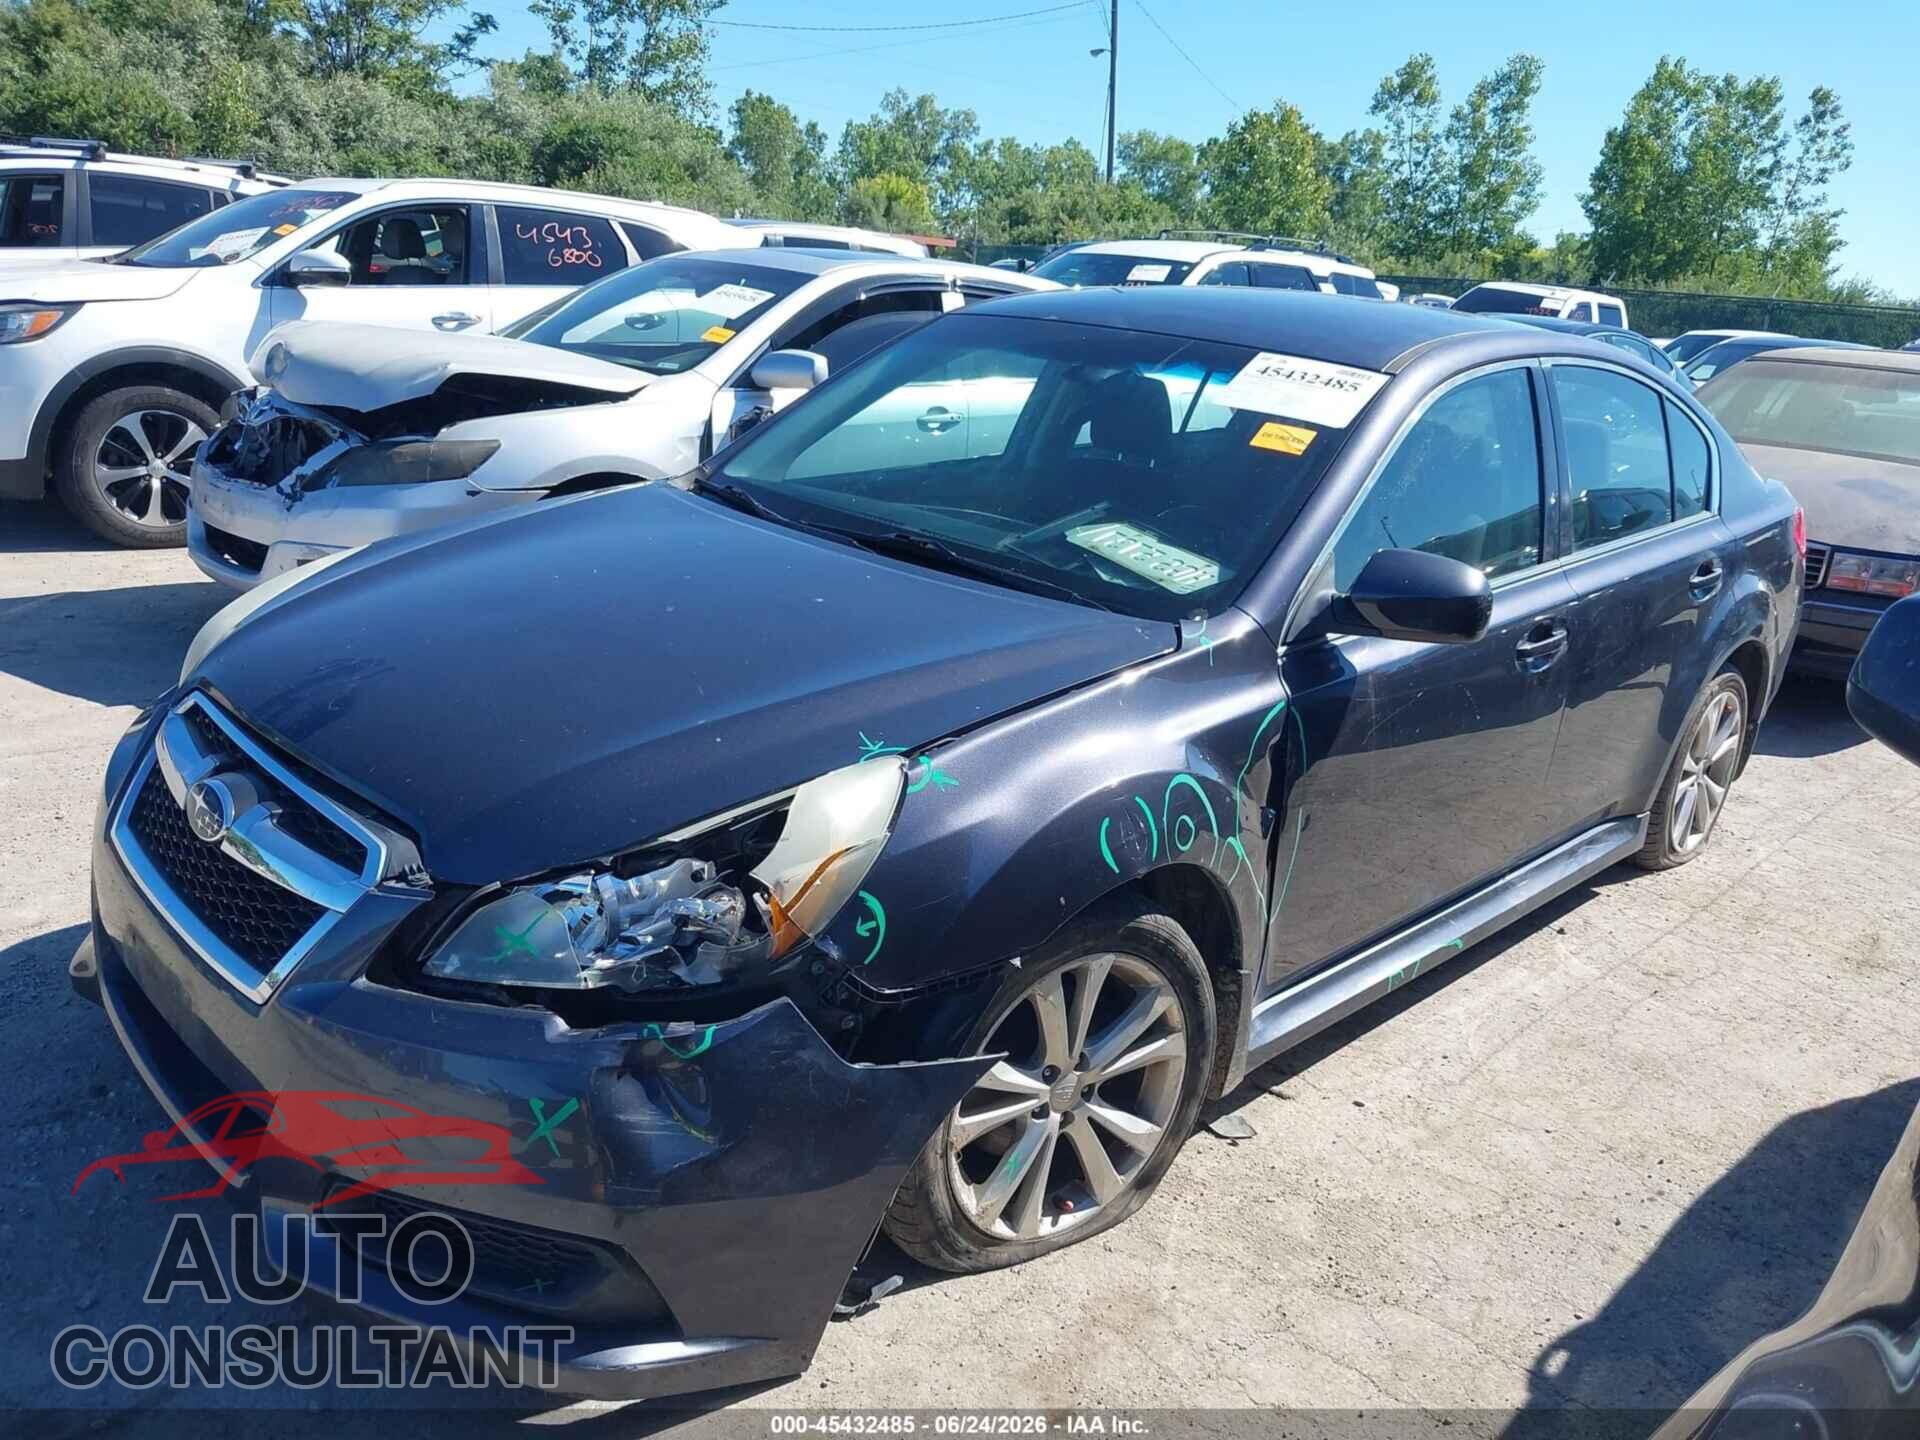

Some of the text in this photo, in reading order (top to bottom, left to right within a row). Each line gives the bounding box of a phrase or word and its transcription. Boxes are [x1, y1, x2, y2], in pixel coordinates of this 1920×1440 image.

[515, 222, 592, 249] 4543
[547, 248, 602, 267] 6800
[1256, 365, 1361, 392] 45432485
